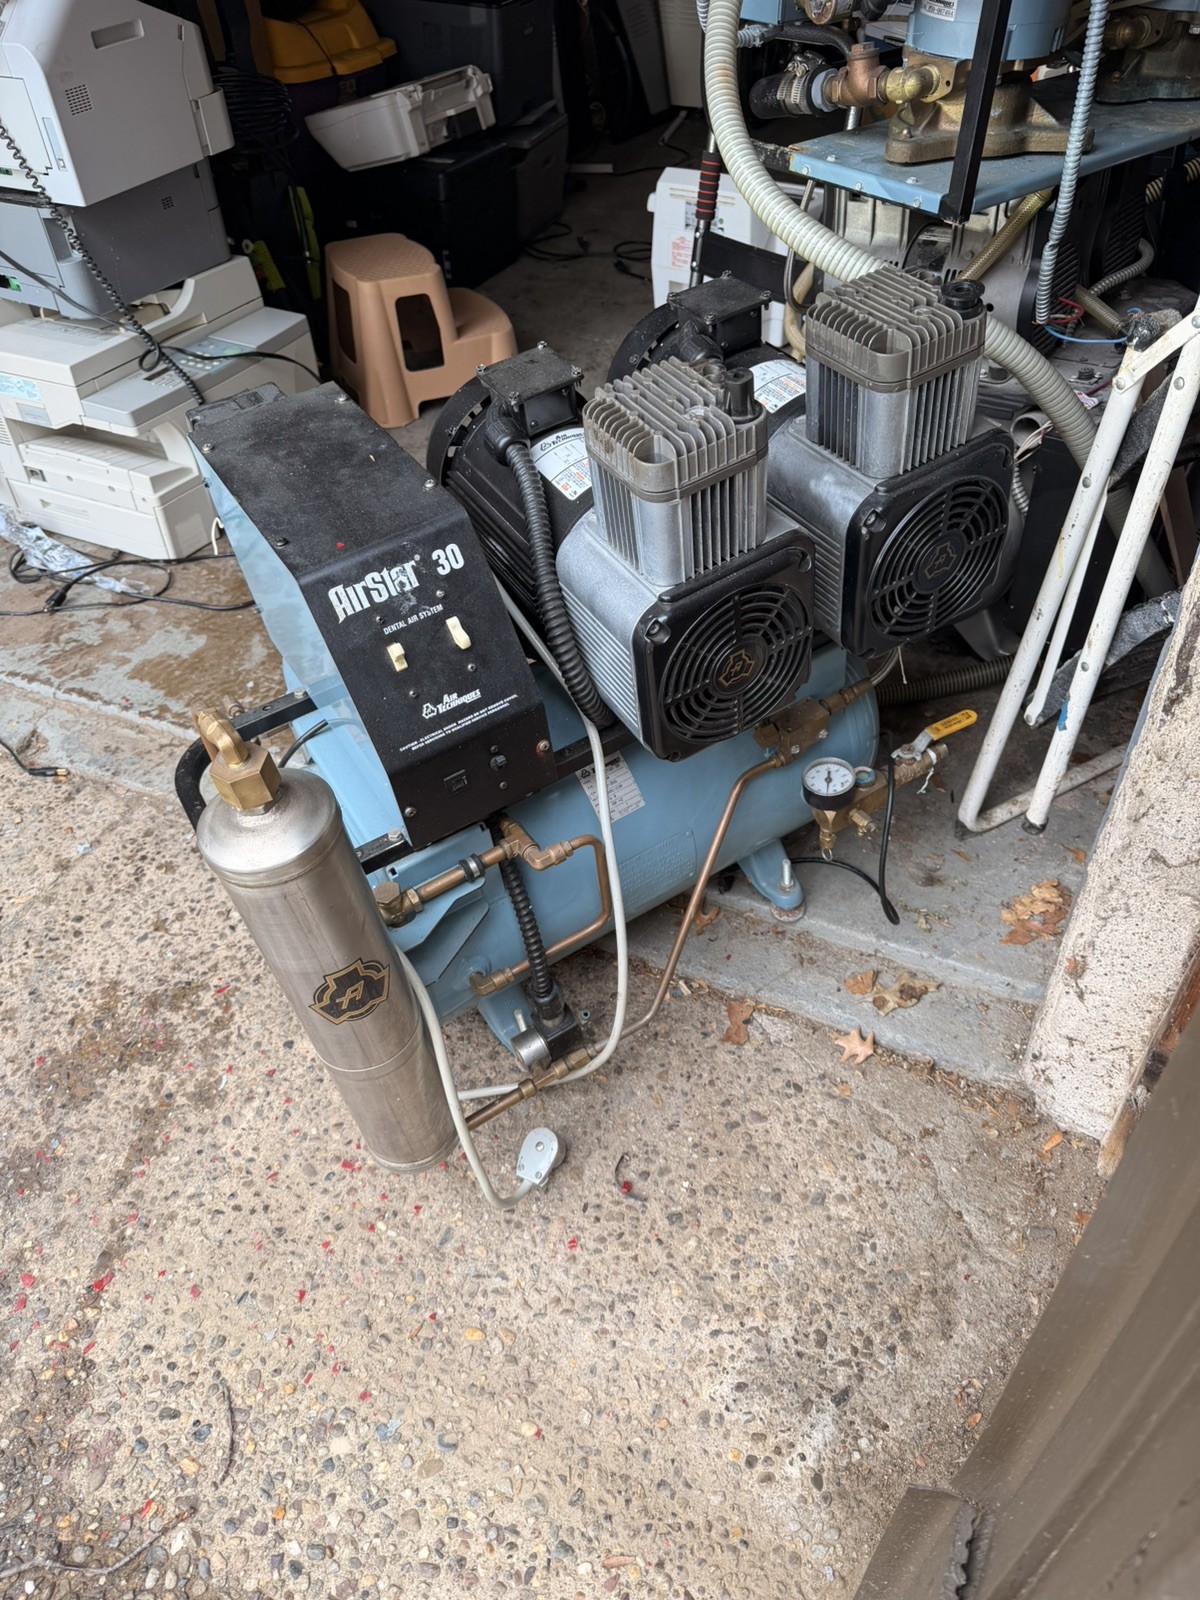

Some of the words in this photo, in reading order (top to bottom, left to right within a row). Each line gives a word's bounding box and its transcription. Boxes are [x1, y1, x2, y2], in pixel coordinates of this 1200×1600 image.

[432, 543, 465, 576] 30
[383, 620, 408, 635] DENTAL
[407, 614, 419, 625] AIR
[419, 604, 444, 620] SYSTEM
[436, 688, 482, 714] TECHNIQUES
[443, 692, 458, 705] AIR
